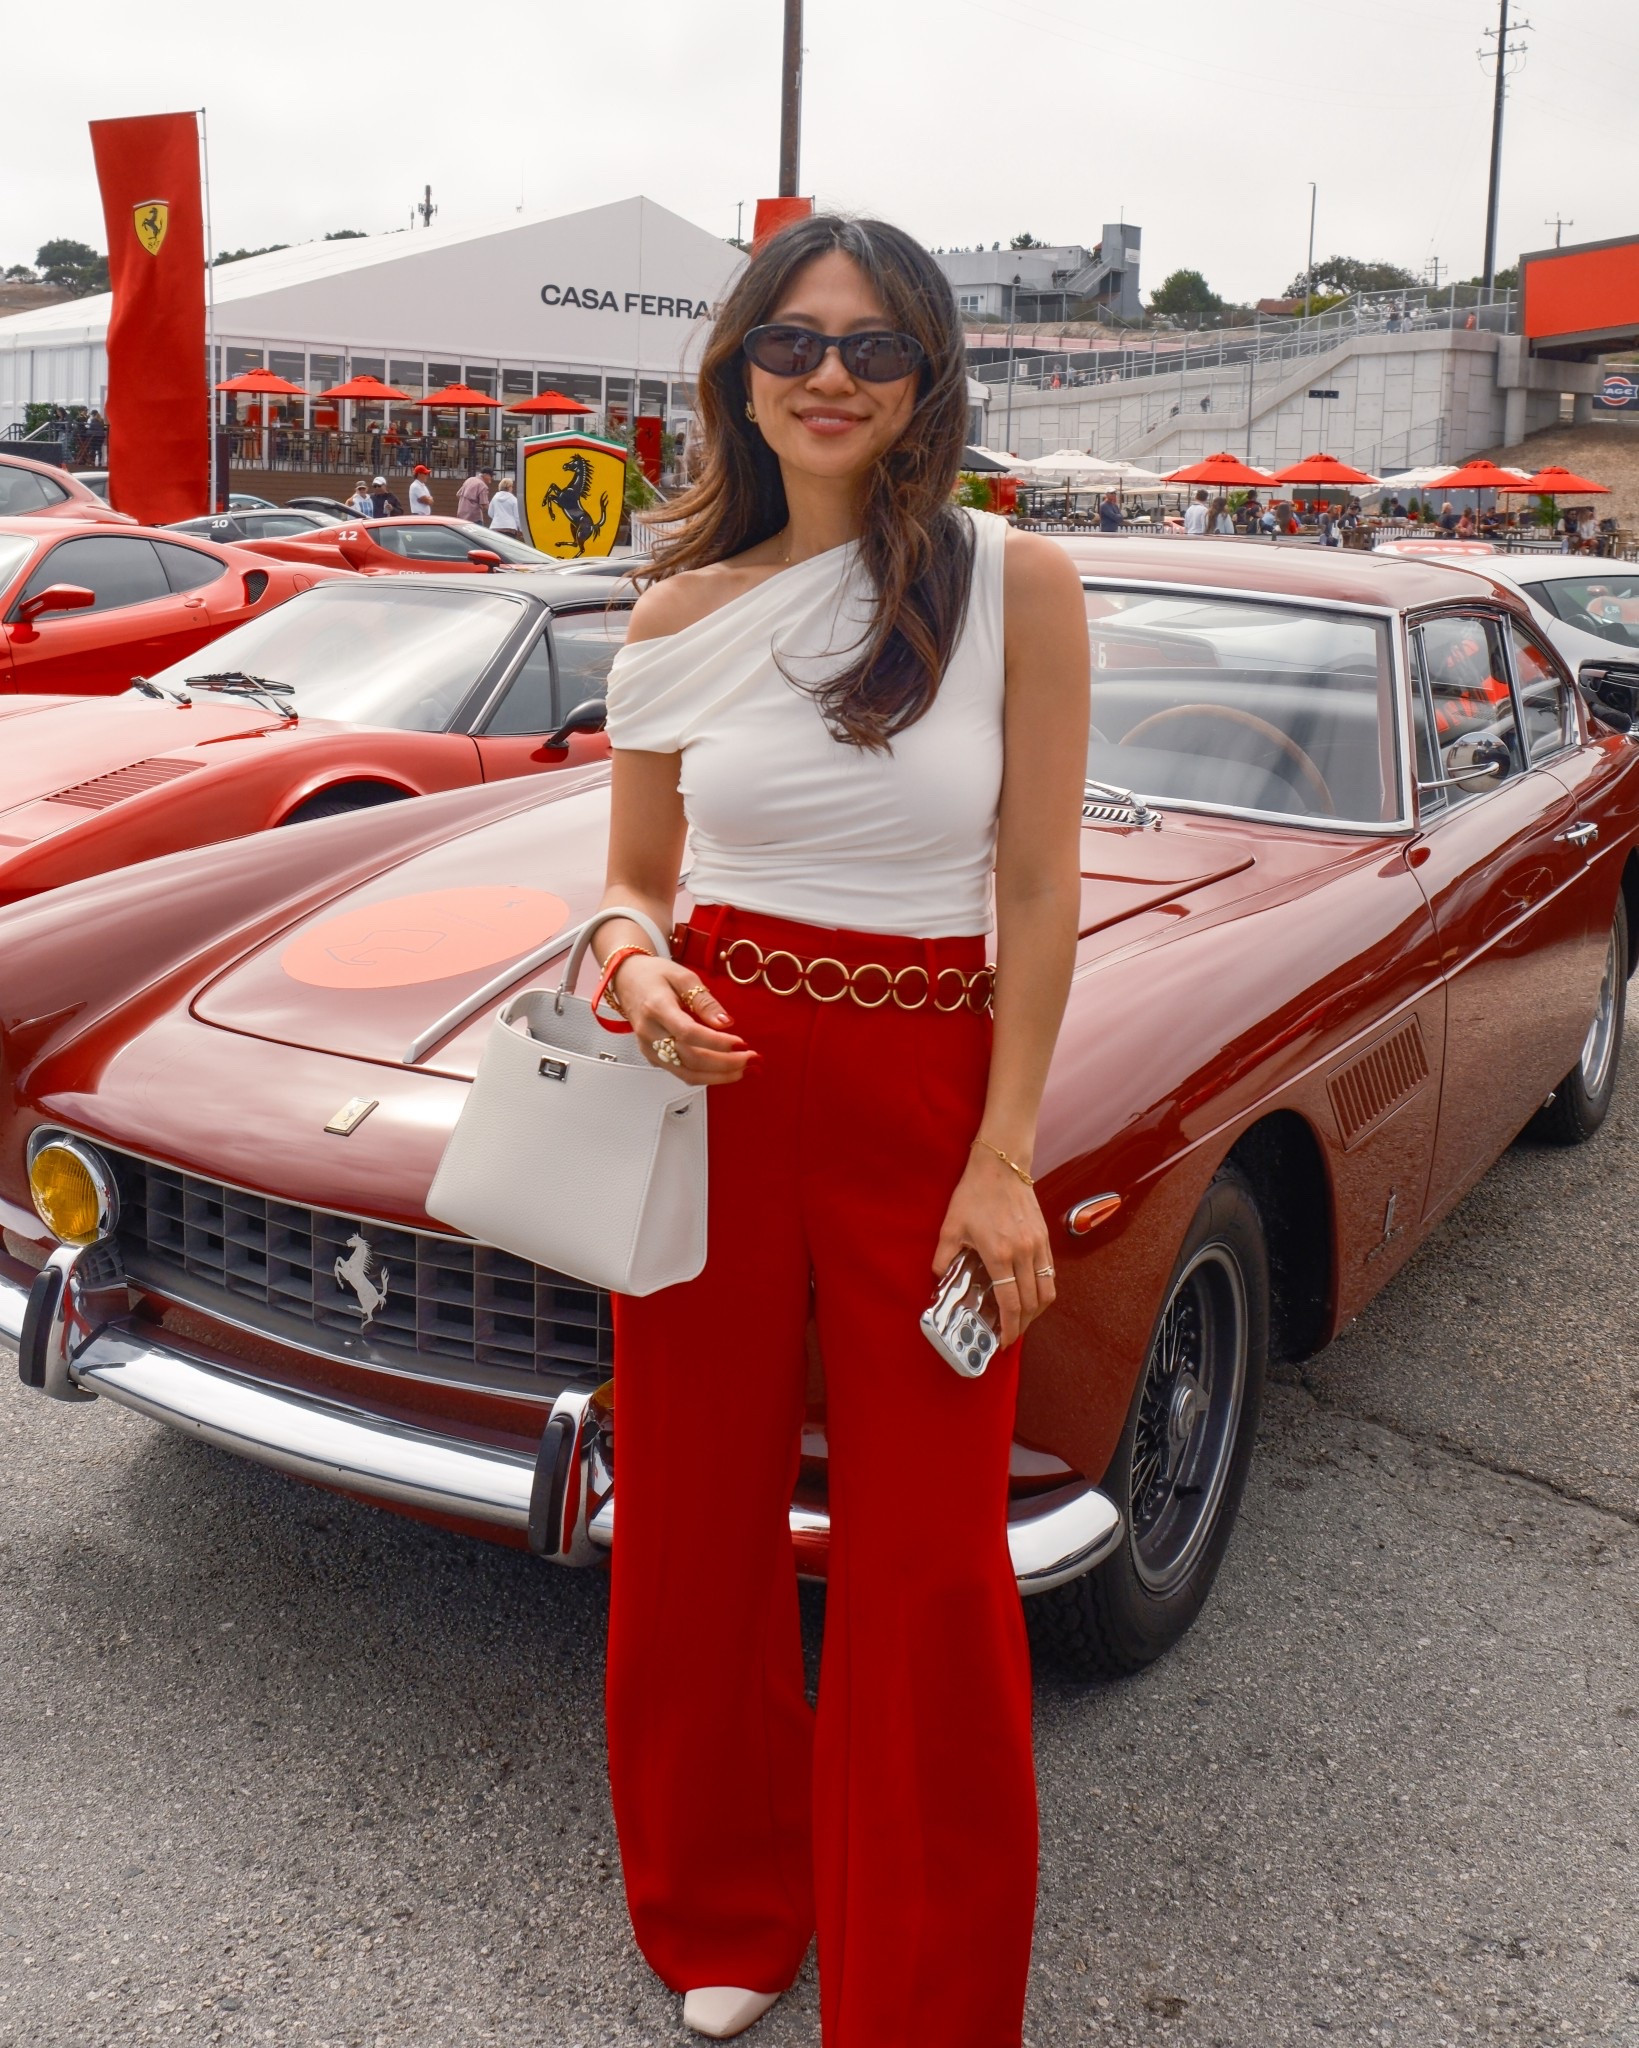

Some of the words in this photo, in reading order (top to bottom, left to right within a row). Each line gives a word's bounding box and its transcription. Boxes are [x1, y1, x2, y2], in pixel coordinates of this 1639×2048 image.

[540, 284, 619, 312] CASA
[624, 292, 718, 321] FERRA
[1603, 387, 1633, 395] AGE
[211, 519, 229, 528] 10
[338, 530, 358, 541] 12
